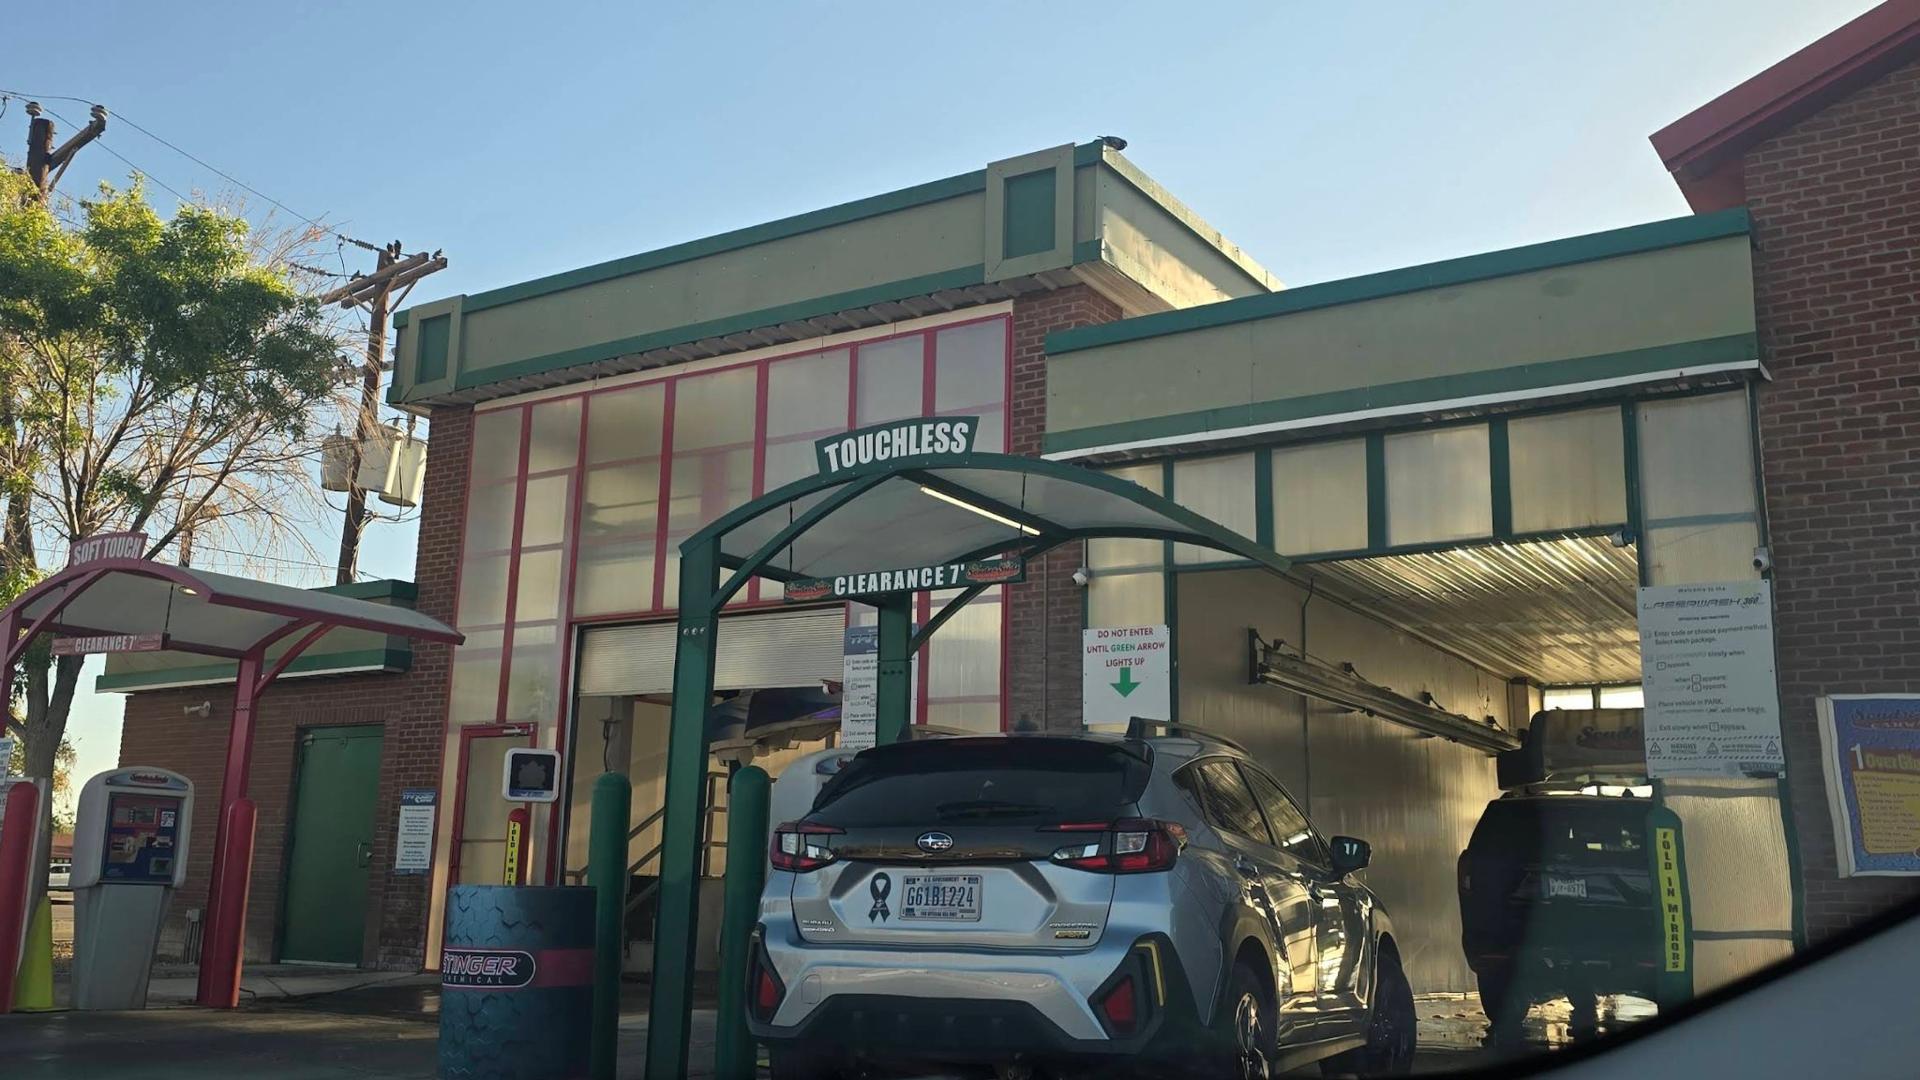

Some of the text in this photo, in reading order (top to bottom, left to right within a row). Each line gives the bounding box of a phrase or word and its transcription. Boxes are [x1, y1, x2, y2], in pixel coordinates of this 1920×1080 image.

[823, 421, 969, 474] TOUCHLESS
[73, 536, 142, 566] SOFT TOUCH
[834, 565, 944, 596] CLEARANCE
[949, 564, 965, 584] 7'
[75, 636, 127, 652] CLEARANCE
[1097, 627, 1154, 639] DO NOT ENTER
[1087, 641, 1165, 653] UNTIL GREEN ARROW
[1105, 657, 1145, 667] LIGHTS UP
[1850, 743, 1864, 770] 1
[906, 886, 974, 908] G61B1224
[1662, 831, 1680, 969] FOLD IN MIRRORS
